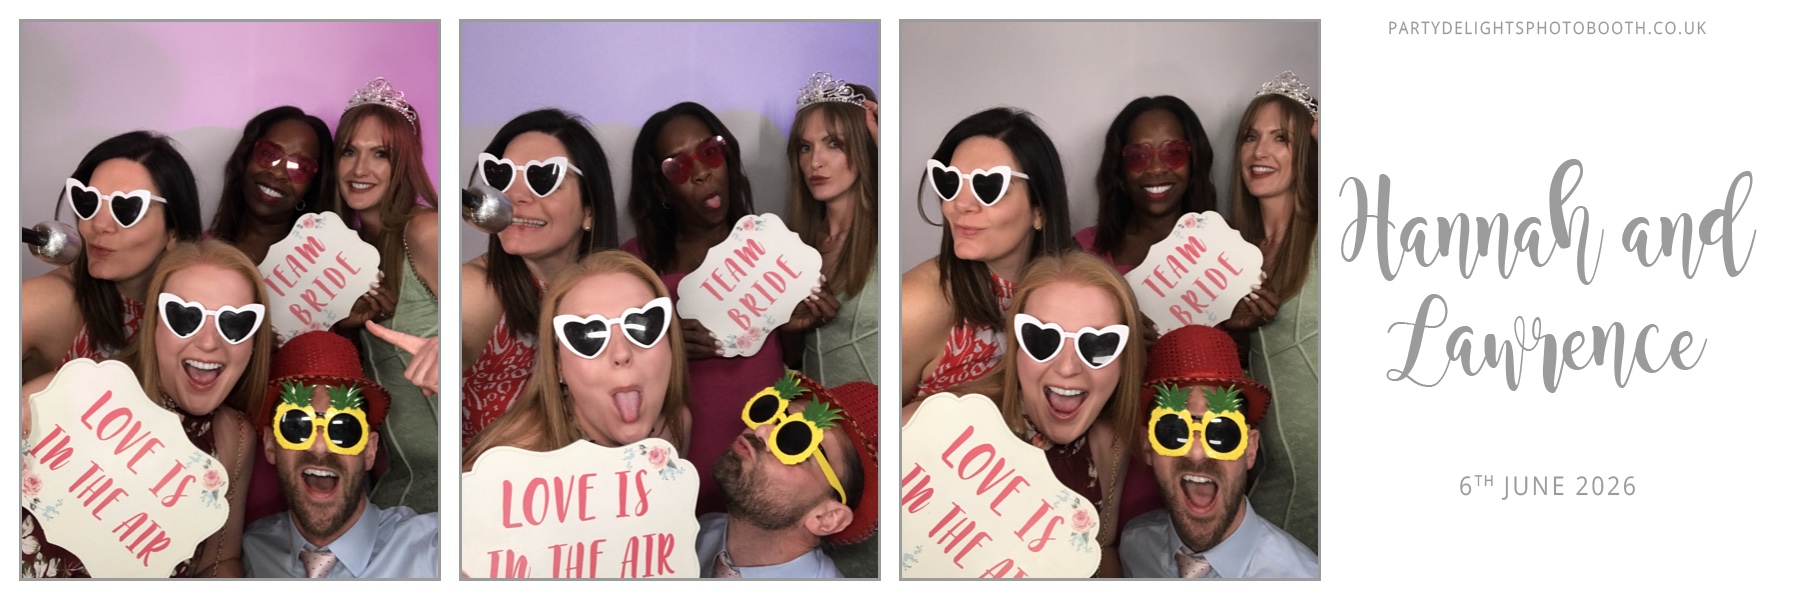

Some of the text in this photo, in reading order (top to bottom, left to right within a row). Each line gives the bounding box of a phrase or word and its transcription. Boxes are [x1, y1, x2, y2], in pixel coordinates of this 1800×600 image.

[263, 236, 326, 297] TEAM
[288, 251, 362, 326] BRIDE
[699, 238, 766, 301] TEAM
[727, 254, 803, 331] BRIDE
[1141, 236, 1207, 298] TEAM
[1169, 251, 1244, 326] BRIDE
[81, 390, 197, 508] LOVE IS
[68, 460, 129, 521] THE
[111, 512, 172, 567] AIR
[502, 468, 653, 529] LOVE IS
[941, 425, 1031, 517] LOVE
[1013, 498, 1065, 553] IS
[548, 538, 607, 578] THE
[620, 532, 676, 578] AIR
[928, 501, 994, 570] THE
